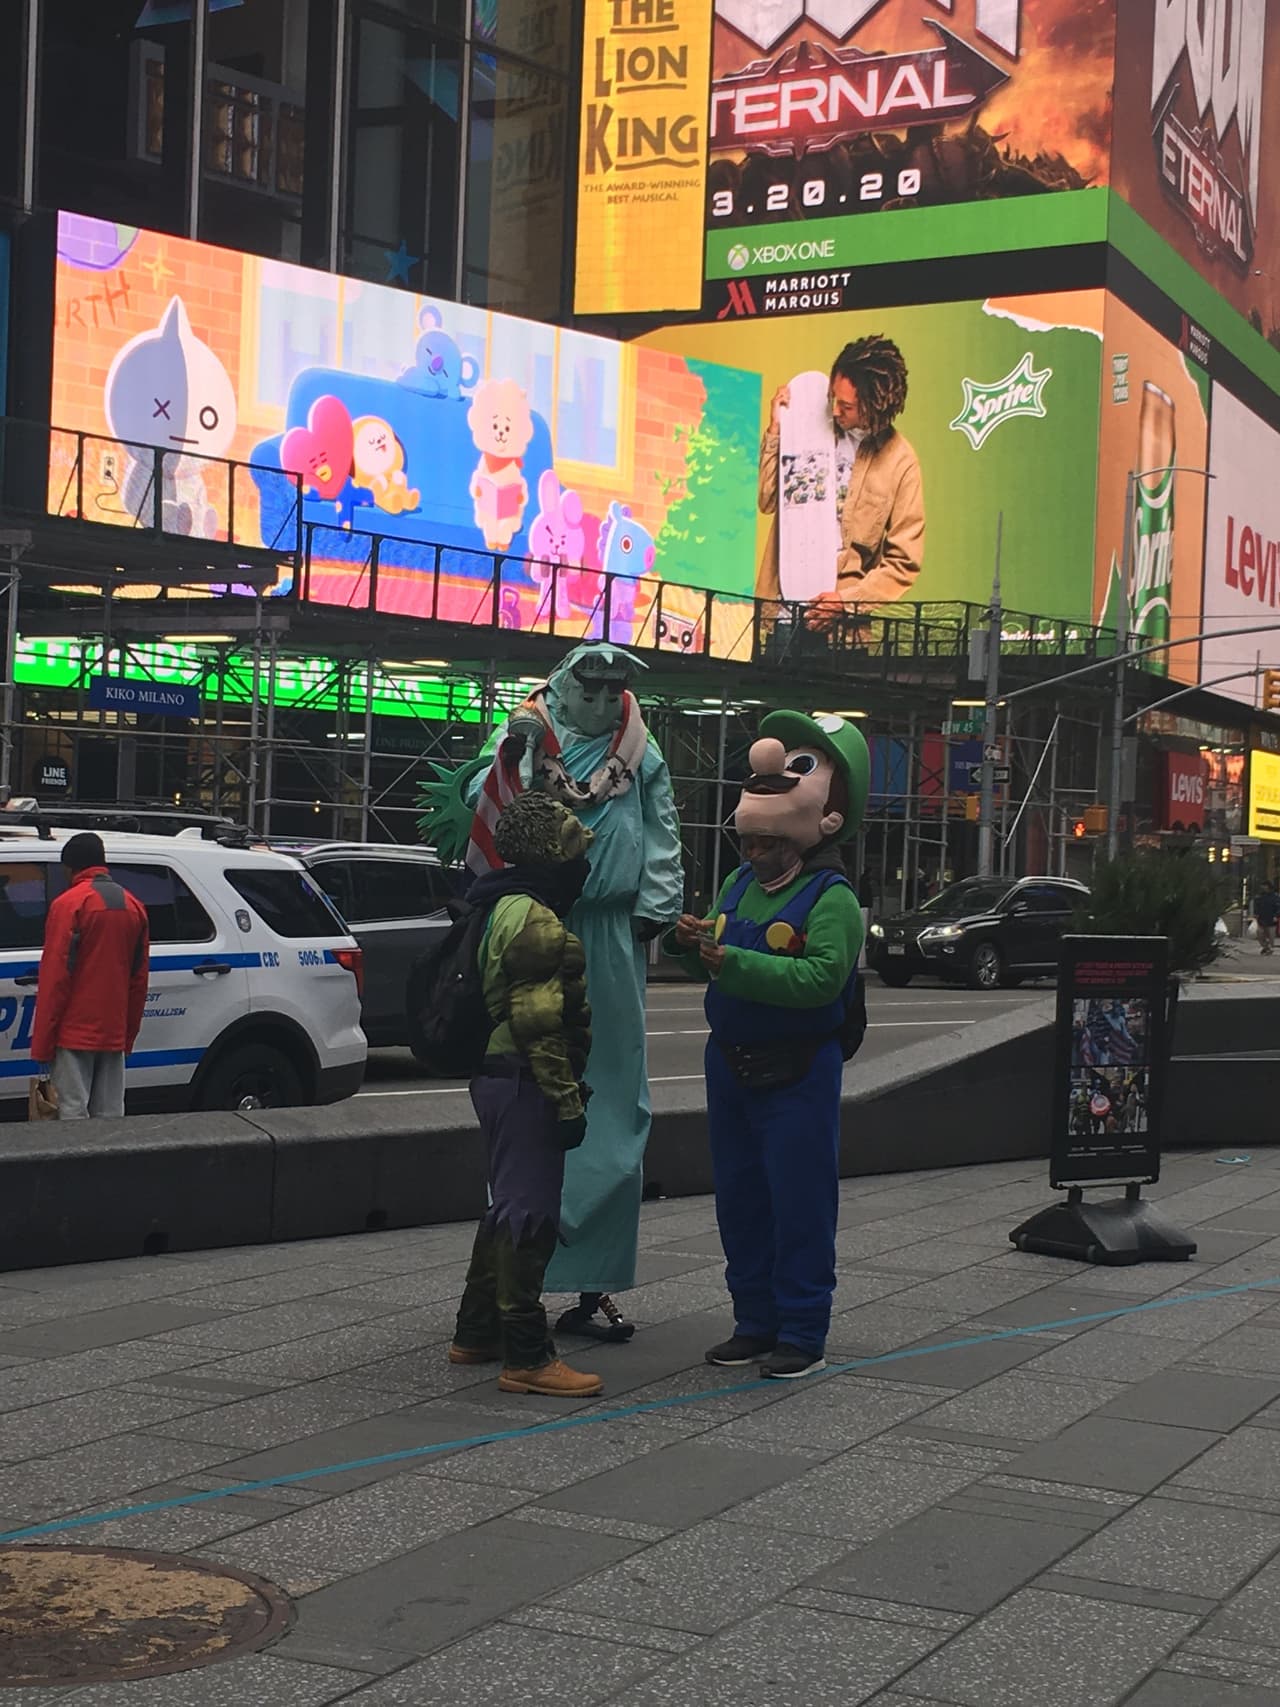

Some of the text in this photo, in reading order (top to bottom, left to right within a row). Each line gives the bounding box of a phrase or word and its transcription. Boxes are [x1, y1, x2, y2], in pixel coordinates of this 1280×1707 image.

[606, 0, 675, 26] THE
[594, 37, 689, 98] LION
[710, 60, 977, 137] TERNAL
[585, 103, 700, 176] KING
[583, 184, 604, 193] THE
[606, 192, 679, 205] BEST MUSICAL
[1162, 120, 1247, 263] ETERNAL
[765, 272, 852, 293] MARRIOTT
[764, 292, 841, 312] MARQUIS
[968, 383, 1034, 424] Sprite
[105, 686, 185, 706] KIKO MILANO
[43, 766, 66, 778] LINE
[262, 951, 280, 968] CRC
